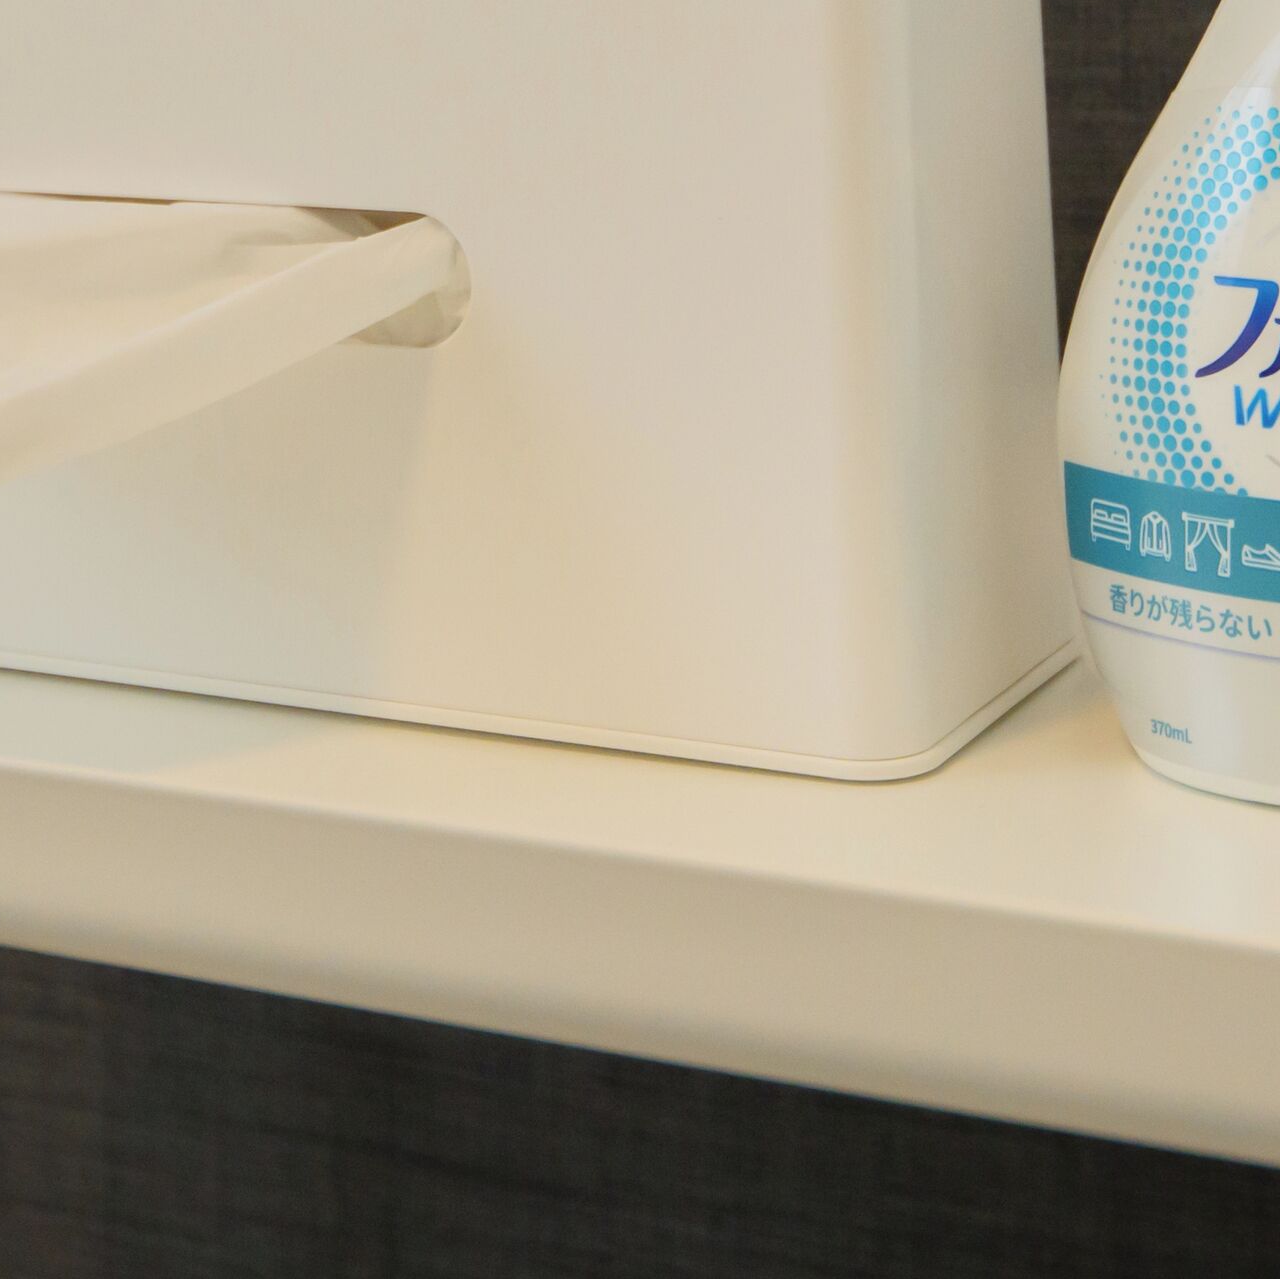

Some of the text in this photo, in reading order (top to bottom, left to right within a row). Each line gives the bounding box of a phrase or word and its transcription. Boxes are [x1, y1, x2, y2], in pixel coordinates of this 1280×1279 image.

[1109, 584, 1272, 640] 香りが残らない
[1150, 719, 1192, 744] 370mL
